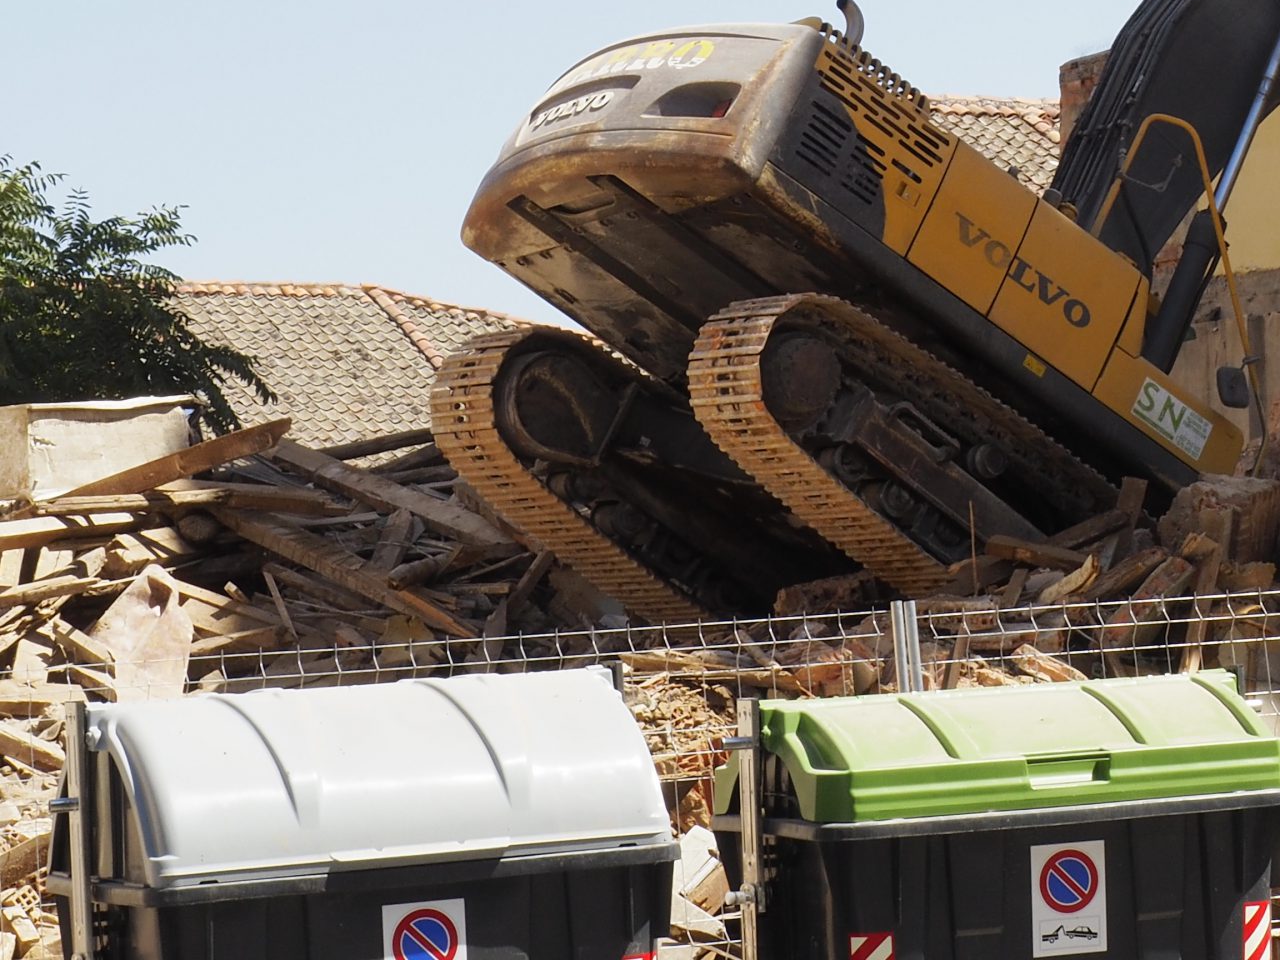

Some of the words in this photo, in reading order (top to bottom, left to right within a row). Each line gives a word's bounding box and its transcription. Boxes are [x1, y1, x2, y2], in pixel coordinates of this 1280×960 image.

[533, 92, 615, 127] VOLVO
[956, 213, 1091, 328] VOLVO
[1137, 382, 1187, 433] SN
